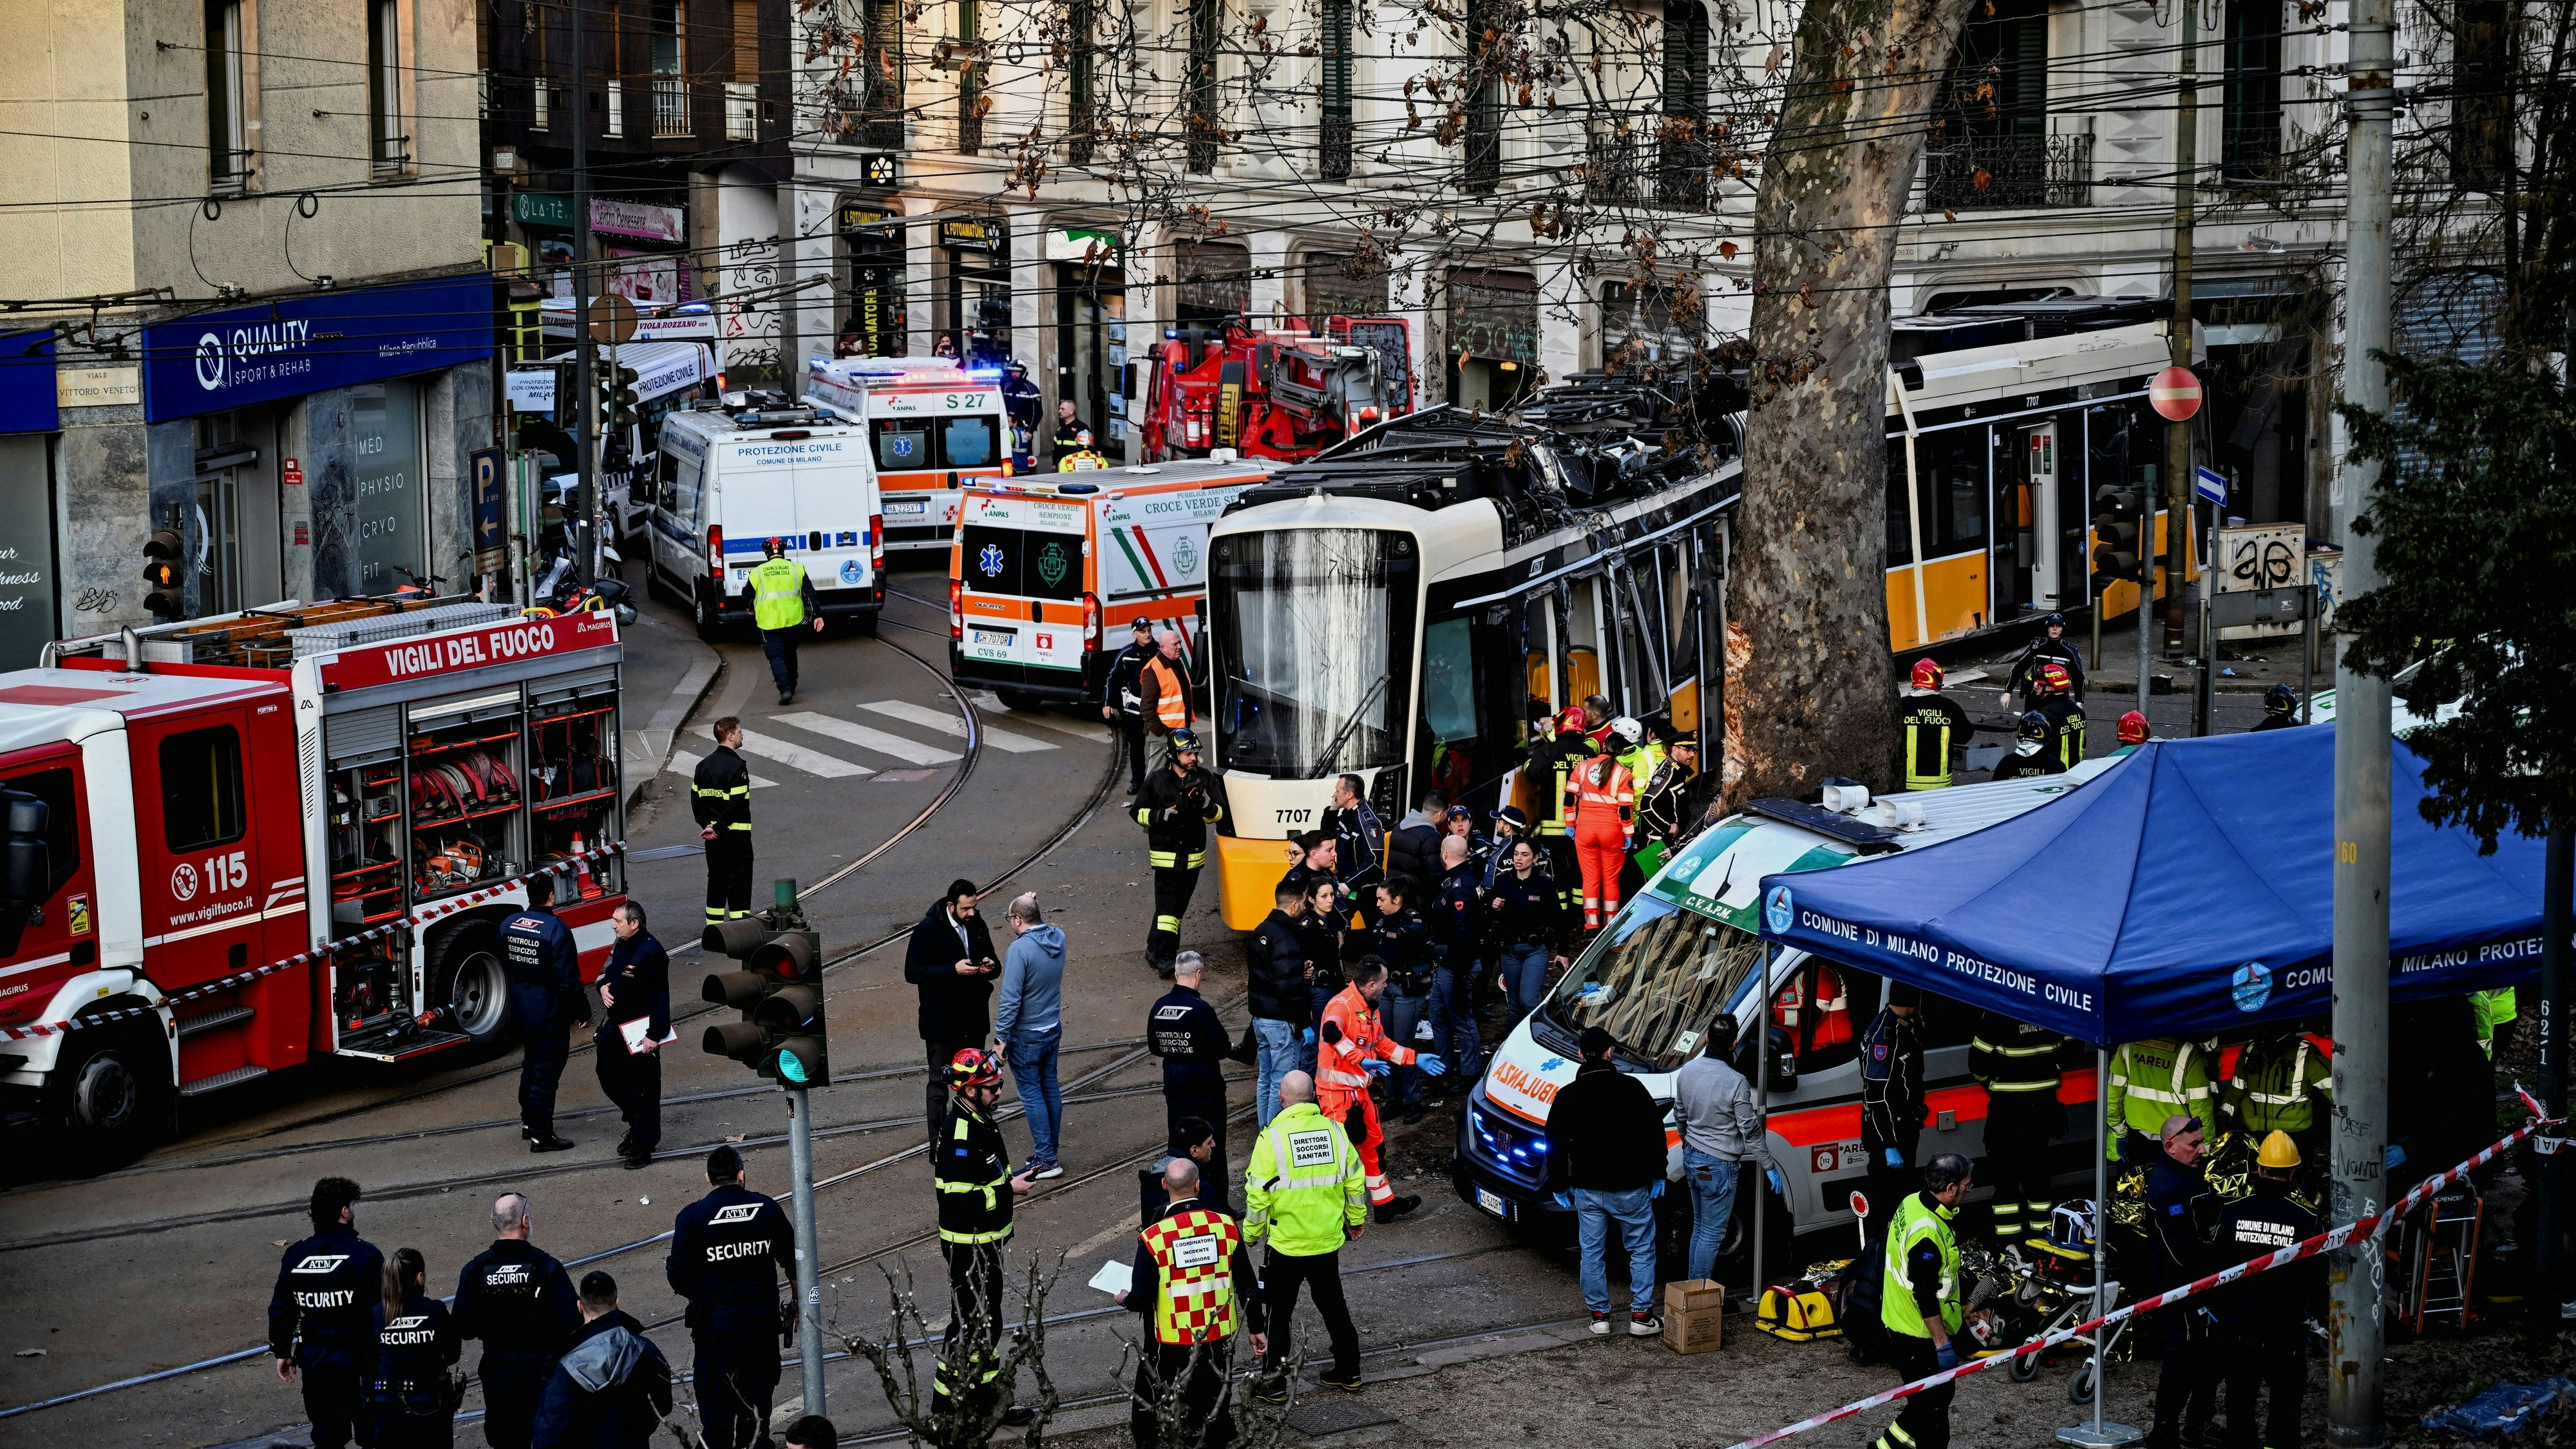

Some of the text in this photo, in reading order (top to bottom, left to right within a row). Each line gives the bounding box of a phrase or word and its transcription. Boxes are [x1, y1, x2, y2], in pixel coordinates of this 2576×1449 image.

[595, 205, 614, 227] Centro
[616, 209, 646, 231] Benessere
[844, 210, 849, 223] IL
[944, 222, 985, 238] IL FOTOAMATORE
[639, 321, 661, 330] VIOLA
[661, 320, 697, 329] ROZZANO
[234, 320, 308, 363] QUALITY
[380, 337, 436, 357] Milano Repubblica
[235, 359, 310, 384] SPORT & REHAB
[639, 365, 694, 395] PROTEZIONE CIVILE
[59, 386, 136, 397] VITTORIO VENETO
[947, 393, 985, 409] S 27
[2026, 395, 2040, 407] 7707
[359, 437, 383, 455] MED
[738, 443, 842, 456] PROTEZIONE CIVILE
[361, 473, 404, 497] PHYSIO
[478, 457, 494, 504] P
[1177, 487, 1244, 498] PUBBLICA ASSISTENZA
[898, 504, 919, 513] 225VT
[1034, 502, 1057, 511] CROCE
[1145, 498, 1221, 515] CROCE VERDE
[1193, 509, 1216, 517] MILANO
[1039, 511, 1072, 520] SEMPIONE
[1112, 511, 1130, 522] ANPAS
[362, 516, 395, 538] CRYO
[364, 562, 379, 580] FIT
[587, 622, 611, 631] MAGIRUS
[989, 635, 1008, 645] 707DR
[384, 624, 554, 676] VIGILI DEL FUOCO
[978, 648, 1007, 658] CVS 69
[1917, 708, 1942, 717] VIGILI
[1904, 715, 1951, 725] DEL FUOCO
[2060, 726, 2071, 734] DEL
[1553, 761, 1569, 770] DEL
[2019, 767, 2045, 776] VIGILI
[1276, 810, 1311, 823] 7707
[205, 851, 248, 894] 115
[170, 896, 253, 925] www.vigilfuoco.it
[1685, 896, 1732, 920] C.V. A.P.M.
[509, 945, 536, 956] ESERCIZIO
[509, 953, 539, 965] SUPERFICIE
[1803, 911, 2092, 1012] COMUNE DI MILANO PROTEZIONE CIVILE
[2401, 950, 2468, 973] MILANO
[2137, 1054, 2171, 1070] AREU
[1294, 1136, 1328, 1145] DIRETTORE
[1296, 1144, 1329, 1153] SOCCORSI
[1297, 1151, 1329, 1160] SANITARI
[725, 1208, 748, 1219] ATM
[2236, 1220, 2295, 1237] COMUNE DI MILANO
[1175, 1238, 1215, 1247] COORDINATORE
[2235, 1231, 2293, 1247] PROTEZIONE CIVILE
[706, 1239, 772, 1262] SECURITY
[308, 1260, 332, 1269] ATM
[1185, 1256, 1211, 1264] MAGGIORE
[486, 1273, 529, 1285] SECURITY
[293, 1291, 354, 1308] SECURITY
[380, 1330, 435, 1345] SECURITY
